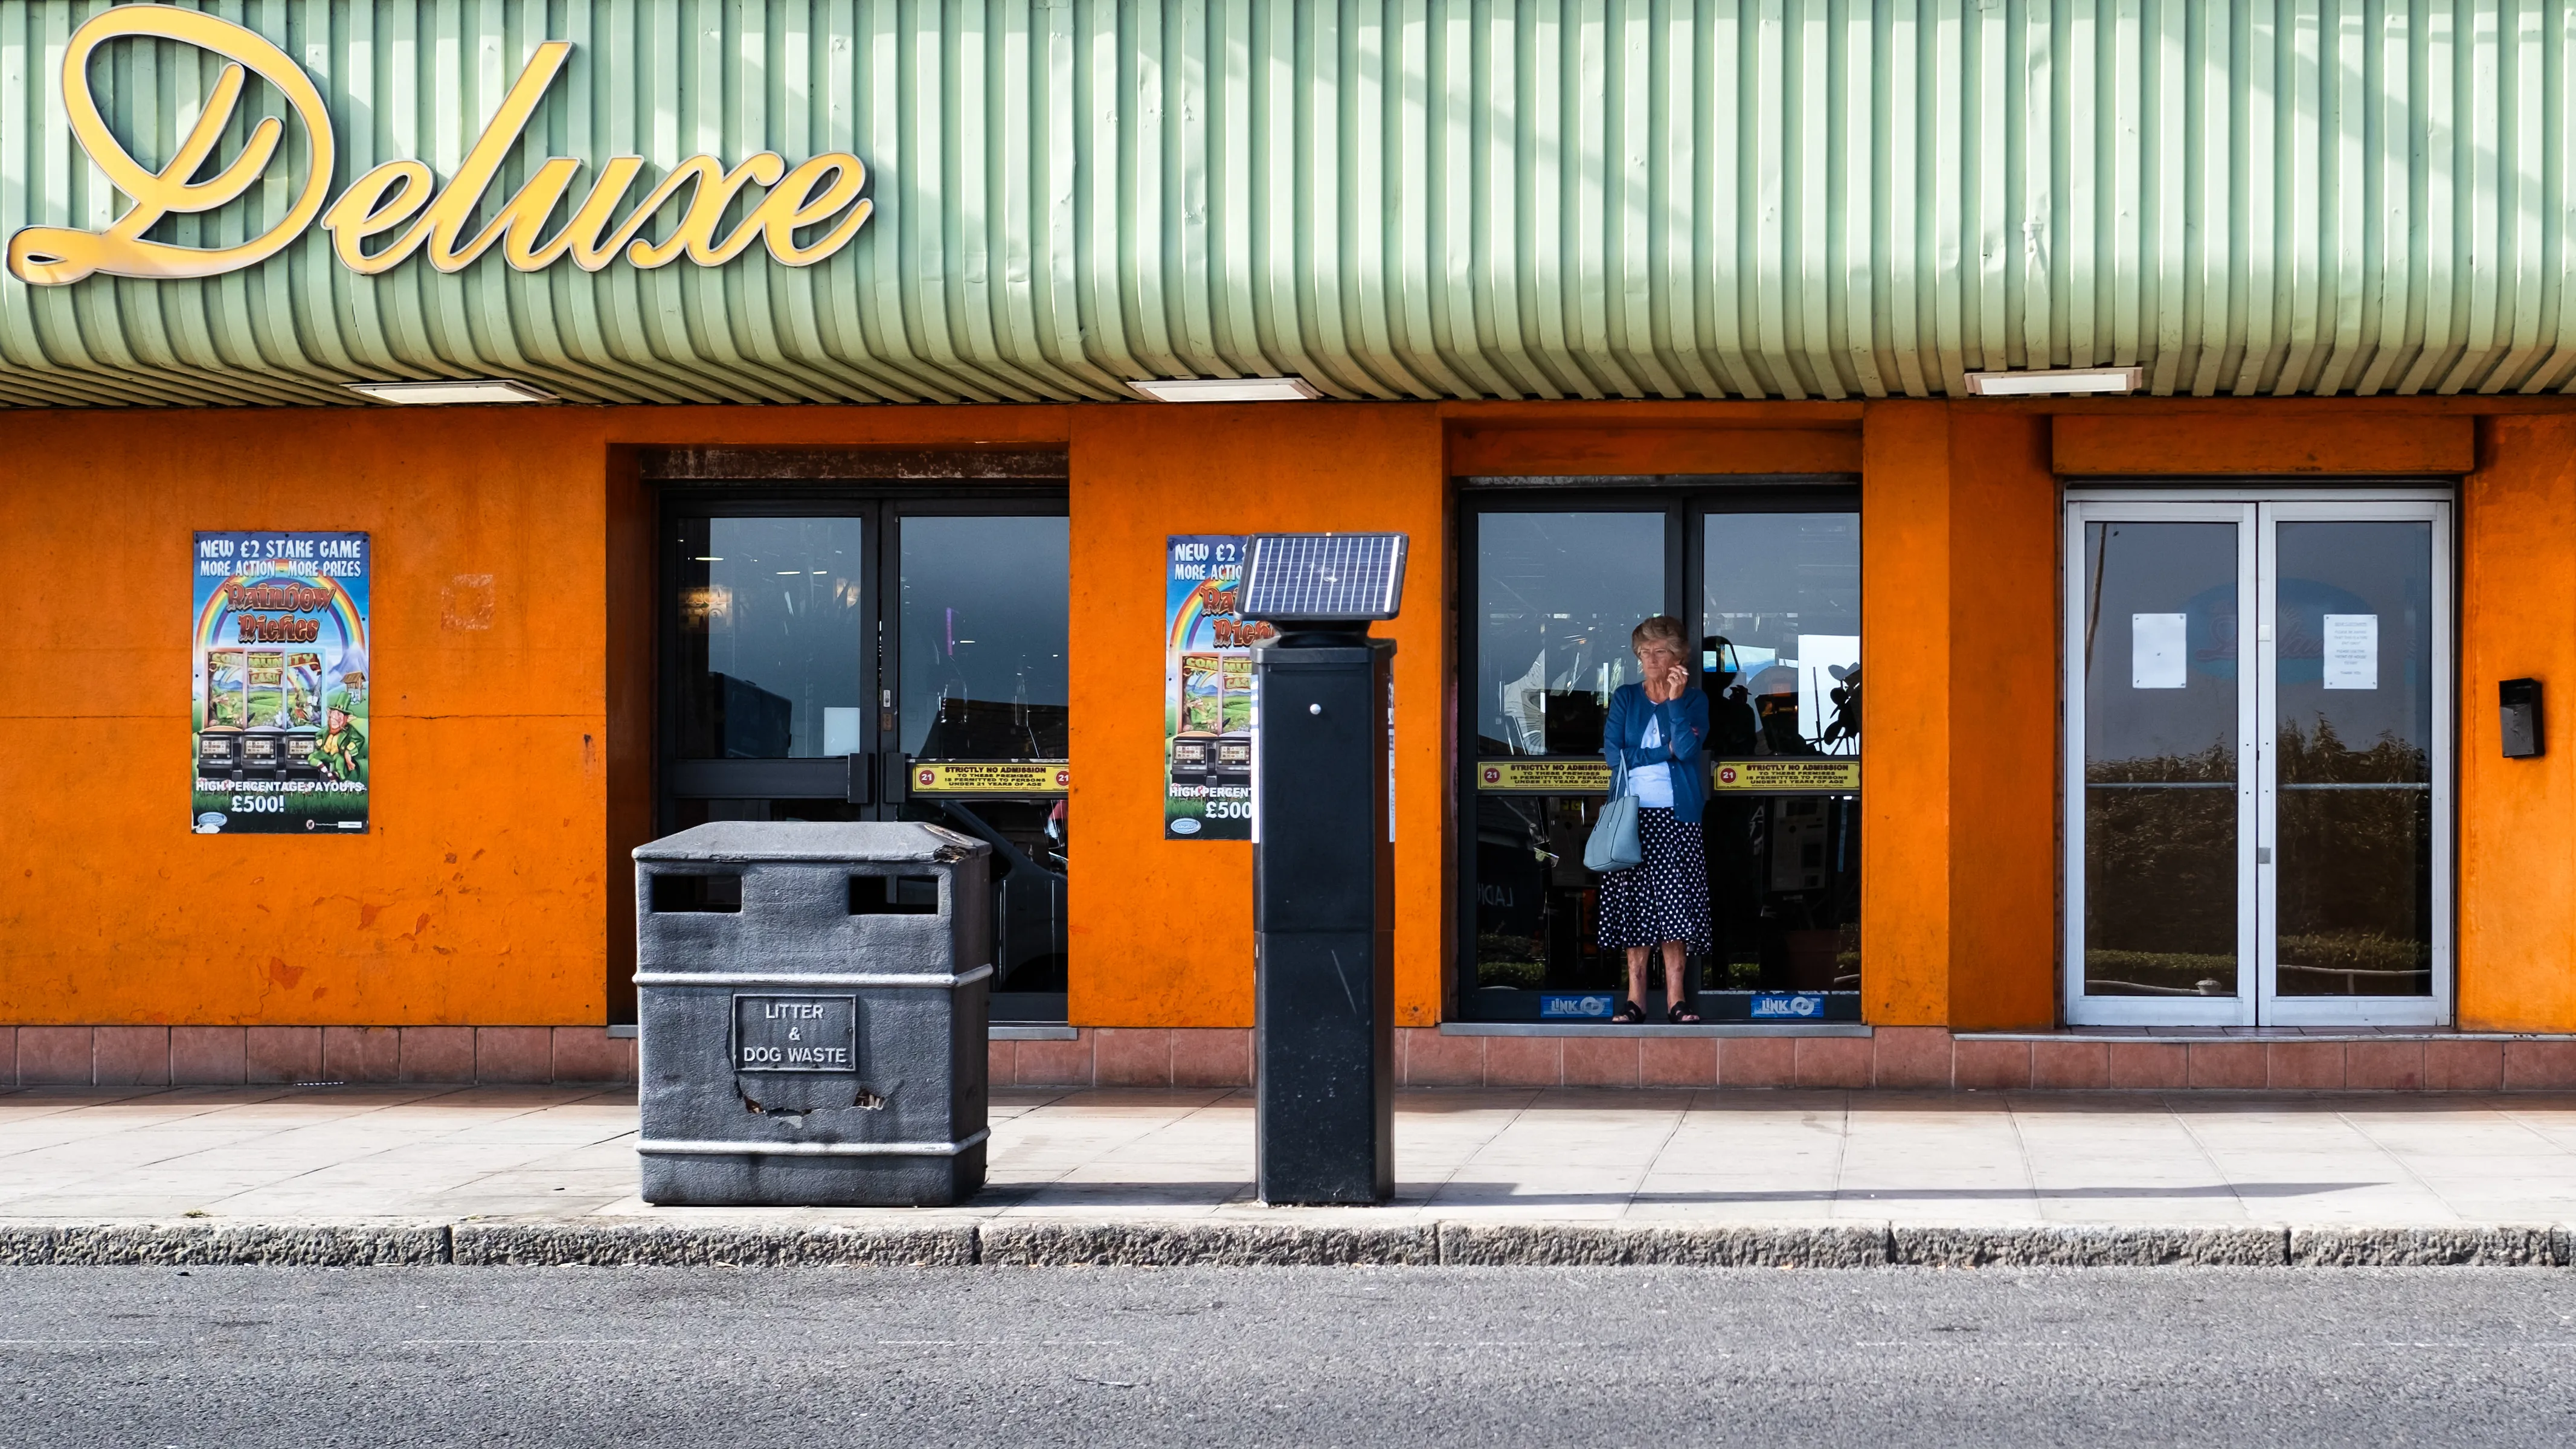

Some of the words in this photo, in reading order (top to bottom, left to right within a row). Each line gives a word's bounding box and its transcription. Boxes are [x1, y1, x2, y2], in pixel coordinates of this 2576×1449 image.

[5, 3, 875, 286] Deluxe
[201, 539, 234, 558] NEW
[240, 539, 260, 558] £2
[266, 540, 315, 558] STAKE
[320, 539, 361, 558] GAME
[1175, 544, 1209, 562] NEW
[1216, 544, 1236, 562] £2
[201, 560, 231, 577] MORE
[236, 560, 275, 577] ACTION
[287, 560, 319, 577] MORE
[323, 560, 362, 577] PRIZES
[1175, 564, 1206, 581] MORE
[1210, 564, 1242, 581] ACTIO
[238, 614, 320, 644] Riches
[1213, 618, 1274, 649] Rich
[251, 673, 280, 683] CASH
[196, 781, 225, 792] HIGH
[227, 781, 306, 792] PERCENTAGE
[309, 781, 363, 792] PAYOUTS
[1169, 786, 1200, 797] HIGH
[231, 795, 285, 812] £500!
[1206, 802, 1251, 818] £500
[765, 1003, 824, 1019] LITTER
[1551, 998, 1578, 1012] LINK
[1762, 998, 1788, 1012] LINK
[789, 1026, 801, 1041] &
[744, 1047, 782, 1062] DOG
[788, 1047, 847, 1063] WASTE
